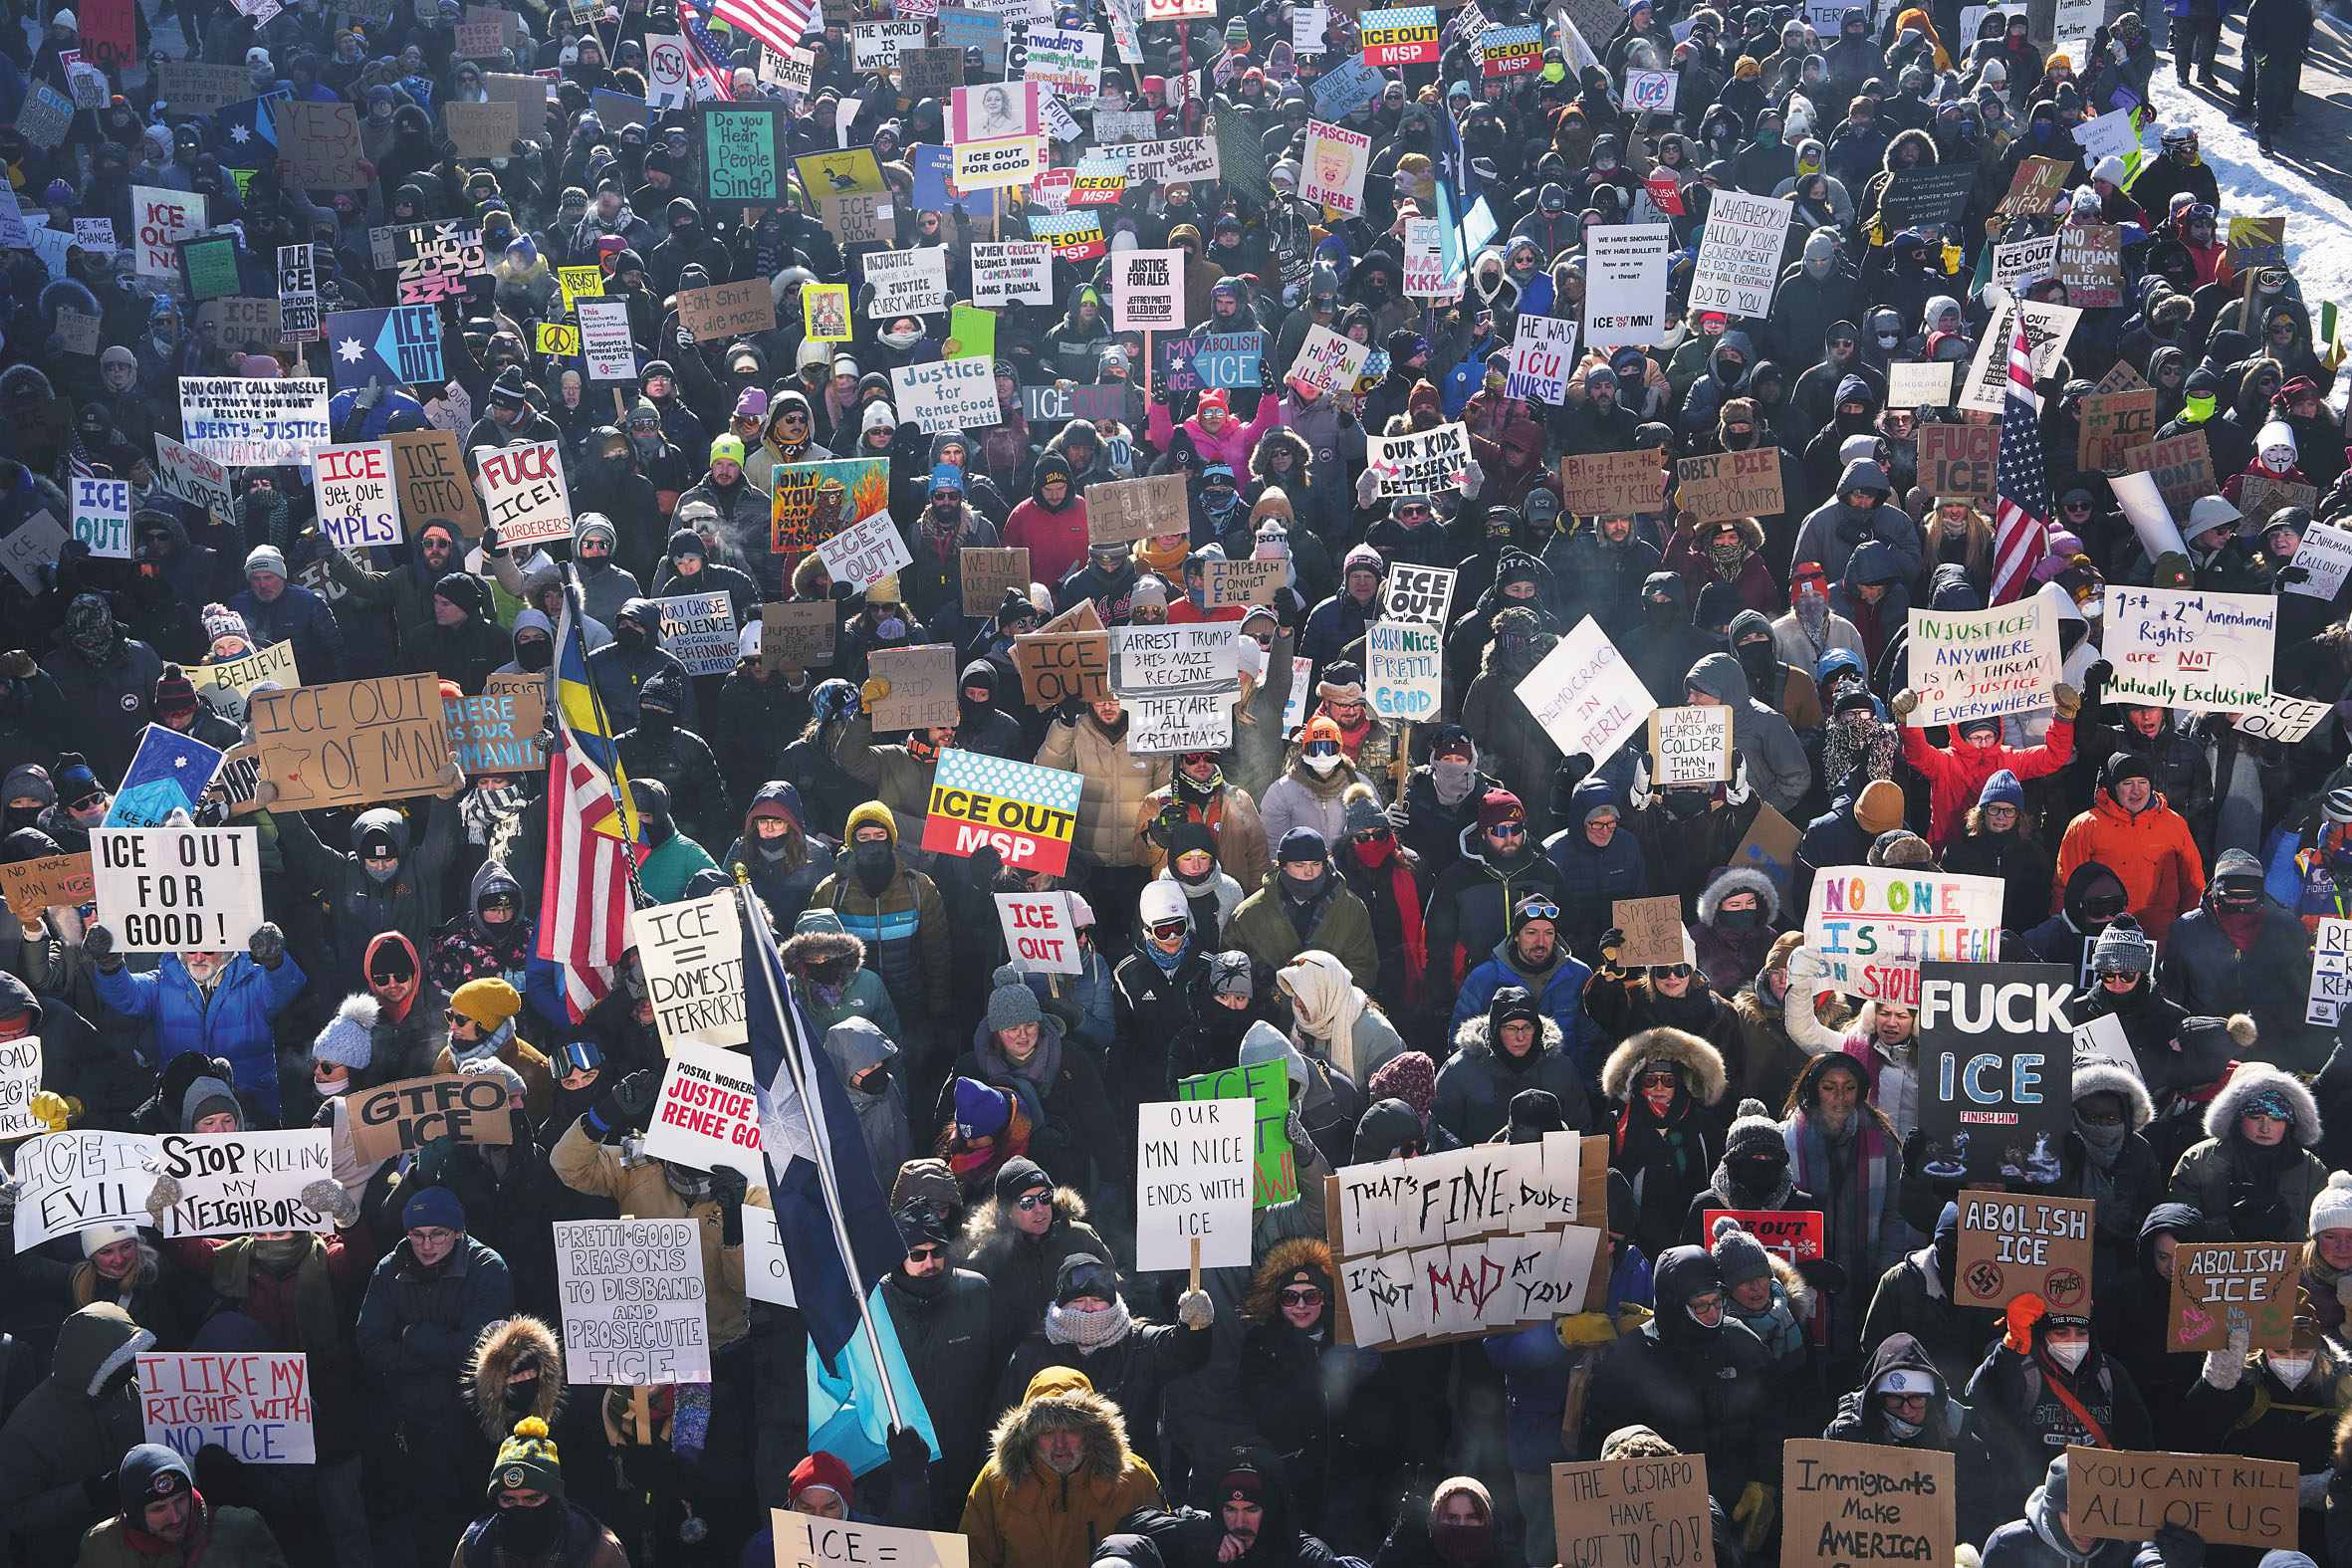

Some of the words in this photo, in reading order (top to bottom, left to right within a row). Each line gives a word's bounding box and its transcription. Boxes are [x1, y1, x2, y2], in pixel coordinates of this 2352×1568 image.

[854, 26, 877, 38] THE
[881, 24, 921, 36] WORLD
[1365, 30, 1392, 44] ICE
[1396, 26, 1436, 43] OUT
[882, 40, 895, 51] IS
[1382, 46, 1422, 62] MSP
[1484, 47, 1506, 59] ICE
[1509, 42, 1540, 56] OUT
[1498, 57, 1529, 71] MSP
[715, 113, 736, 127] Do
[741, 116, 763, 130] you
[721, 130, 758, 141] Hear
[1308, 121, 1367, 148] FASCISM
[968, 152, 990, 162] ICE
[995, 148, 1022, 160] OUT
[963, 163, 989, 174] FOR
[994, 159, 1030, 170] GOOD
[1072, 177, 1094, 188] ICE
[1098, 175, 1126, 187] OUT
[1081, 190, 1112, 201] MSP
[1306, 184, 1318, 199] IS
[1321, 188, 1354, 210] HERE
[839, 197, 873, 214] ICE
[77, 221, 86, 230] BE
[840, 215, 874, 230] OUT
[78, 230, 114, 245] CHANGE
[844, 228, 875, 241] NOW
[1706, 225, 1745, 245] ALLOW
[1752, 231, 1778, 250] YOUR
[2062, 230, 2084, 247] NO
[974, 246, 1004, 257] WHEN
[1007, 245, 1048, 255] CRUELTY
[1702, 246, 1773, 264] GOVERNMENT
[1999, 253, 2020, 268] ICE
[2025, 246, 2053, 261] OUT
[2061, 249, 2118, 265] HUMAN
[866, 253, 914, 271] INJUSTICE
[974, 259, 1007, 269] BECOMES
[1012, 257, 1041, 266] NORMAL
[1128, 259, 1168, 273] JUSTICE
[2010, 262, 2049, 276] MINNESOTA
[280, 271, 312, 291] ICE
[566, 273, 596, 291] RESIST
[982, 268, 1033, 280] COMPASSION
[1127, 273, 1146, 286] FOR
[1147, 273, 1169, 286] ALEX
[2063, 275, 2114, 285] ILLEGAL
[889, 279, 930, 295] JUSTICE
[976, 285, 1001, 295] LOOKS
[1005, 284, 1041, 295] RADICAL
[1152, 296, 1171, 305] PRETTI
[1695, 286, 1712, 302] DO
[1717, 288, 1731, 306] TO
[1739, 291, 1761, 310] YOU
[1521, 316, 1541, 338] HE
[1547, 321, 1574, 342] WAS
[1166, 340, 1195, 359] MN
[1204, 336, 1260, 352] ABOLISH
[1327, 337, 1348, 353] NO
[1533, 341, 1547, 350] AN
[1320, 364, 1332, 377] IS
[1519, 350, 1561, 376] ICU
[935, 385, 961, 399] for
[923, 416, 953, 431] Alex
[959, 411, 998, 427] Pretti
[1384, 440, 1419, 459] OUR
[1425, 428, 1460, 458] KIDS
[318, 449, 386, 480] ICE
[481, 446, 557, 488] FUCK
[781, 471, 816, 488] ONLY
[81, 482, 127, 511] ICE
[780, 488, 816, 507] YOU
[785, 508, 809, 517] CAN
[324, 514, 393, 545] MPLS
[823, 524, 875, 565] ICE
[866, 569, 884, 584] NOW!
[1394, 569, 1449, 595] ICE
[659, 603, 684, 621] YOU
[687, 599, 726, 616] CHOSE
[1392, 592, 1445, 616] OUT
[1918, 616, 2033, 641] INJUSTICE
[2139, 621, 2194, 648] Rights
[1123, 633, 1177, 651] ARREST
[1191, 631, 1231, 646] TRUMP
[1935, 639, 2034, 665] ANYWHERE
[1146, 667, 1215, 684] REGIME
[1917, 688, 1944, 704] TO
[1969, 677, 2039, 698] JUSTICE
[1933, 693, 2050, 722] EVERYWHERE
[1675, 711, 1707, 724] NAZI
[1661, 725, 1701, 738] HEARTS
[1703, 724, 1725, 735] ARE
[1661, 738, 1723, 753] COLDER
[1671, 757, 1705, 766] THAN
[1671, 763, 1715, 778] THIS!!
[931, 787, 989, 823] ICE
[999, 802, 1074, 837] OUT
[102, 836, 146, 867] ICE
[178, 834, 241, 867] OUT
[8, 866, 26, 878] NO
[38, 858, 70, 870] MORE
[137, 876, 203, 907] FOR
[1826, 877, 1865, 912] NO
[1887, 879, 1961, 914] ONE
[1008, 903, 1056, 928] ICE
[1637, 925, 1667, 938] LIKE
[1018, 938, 1064, 963] OUT
[1921, 981, 2073, 1033] FUCK
[1939, 1053, 2045, 1103] ICE
[361, 1081, 506, 1125] GTFO
[668, 1077, 754, 1120] JUSTICE
[661, 1101, 728, 1139] RENEE
[1171, 1107, 1219, 1126] OUR
[1961, 1112, 1992, 1123] FINISH
[1994, 1113, 2017, 1124] HIM
[1146, 1141, 1177, 1168] MN
[1193, 1137, 1244, 1164] NICE
[223, 1179, 257, 1197] MY
[1148, 1183, 1191, 1206] ENDS
[1200, 1178, 1244, 1200] WITH
[1179, 1216, 1213, 1235] ICE
[1966, 1202, 2086, 1239] ABOLISH
[1996, 1234, 2048, 1266] ICE
[572, 1248, 686, 1275] REASONS
[2190, 1250, 2286, 1274] ABOLISH
[565, 1280, 593, 1303] TO
[602, 1277, 704, 1301] DISBAND
[2202, 1278, 2267, 1303] ICE
[613, 1304, 657, 1320] AND
[567, 1318, 702, 1349] PROSECUTE
[589, 1349, 676, 1385] ICE
[1563, 1468, 1609, 1501] THE
[1623, 1462, 1692, 1494] GESTAPO
[2075, 1462, 2135, 1488] YOU
[2142, 1466, 2223, 1488] CAN'T
[2234, 1469, 2294, 1489] KILL
[1610, 1501, 1656, 1526] HAVE
[1842, 1497, 1901, 1523] Make
[1817, 1522, 1932, 1560] AMERICA
